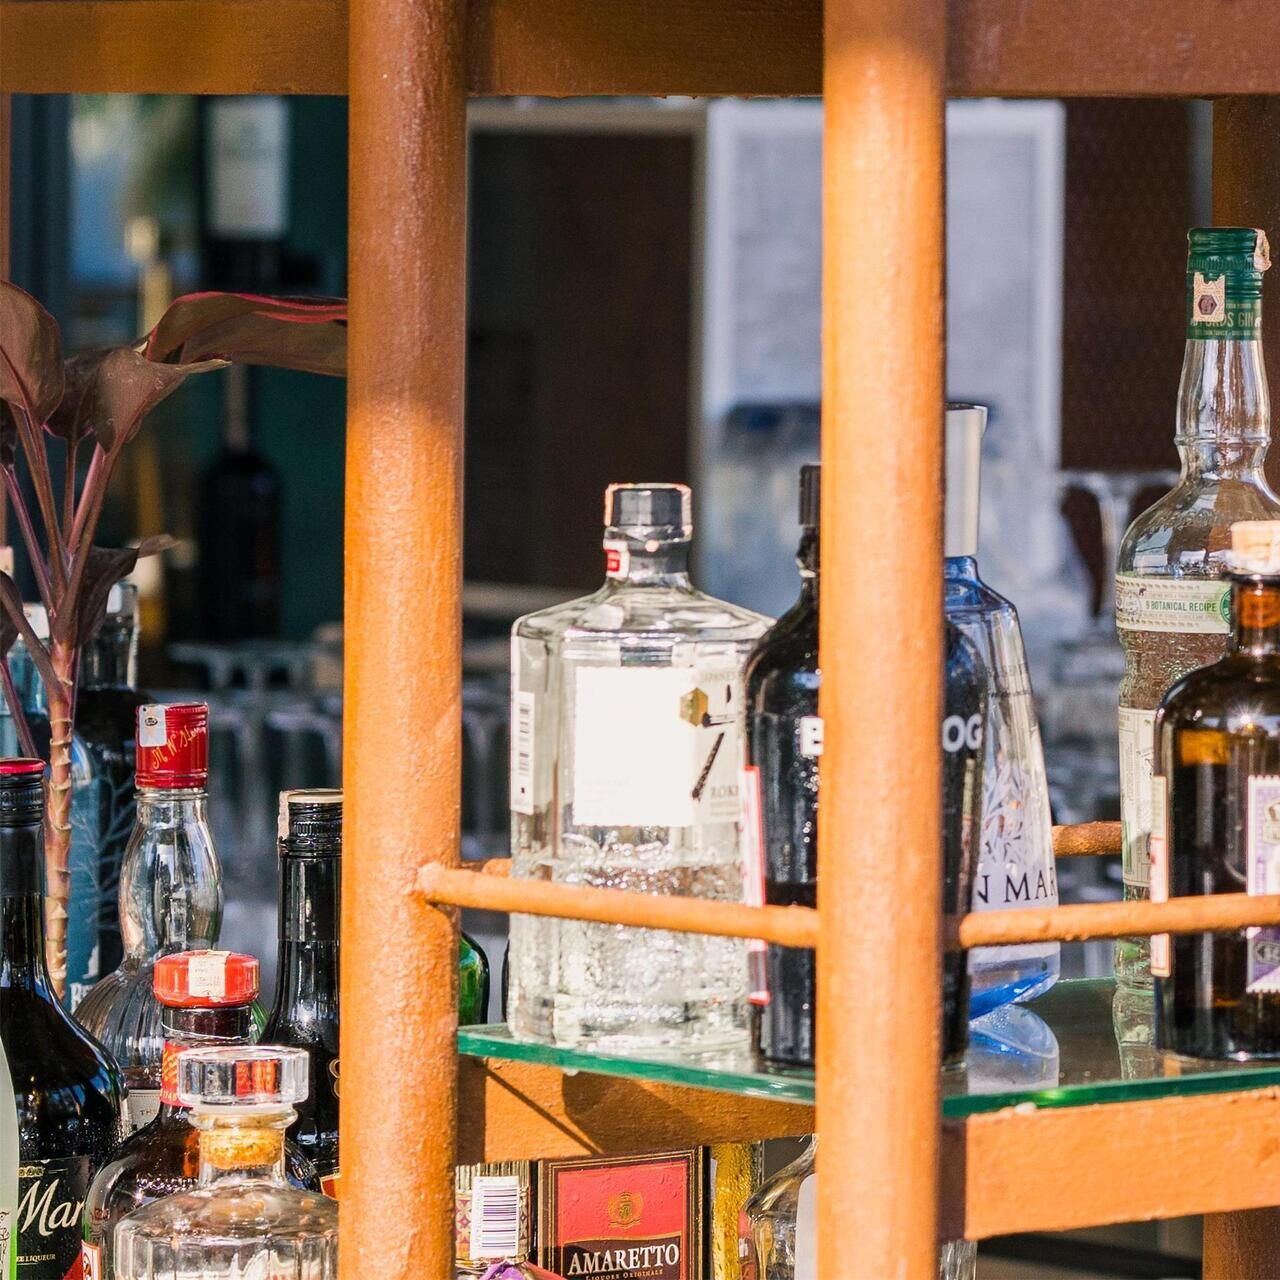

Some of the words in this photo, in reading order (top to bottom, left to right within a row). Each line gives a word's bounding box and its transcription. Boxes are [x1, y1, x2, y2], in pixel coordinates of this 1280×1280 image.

[1238, 311, 1254, 328] GIN
[1151, 599, 1187, 611] BOTANICAL
[1189, 600, 1217, 612] RECIPE
[17, 1178, 86, 1237] Mar
[26, 1253, 56, 1263] LIQUEUR
[567, 1243, 680, 1276] AMARETTO
[622, 1269, 664, 1279] ORIGINALE
